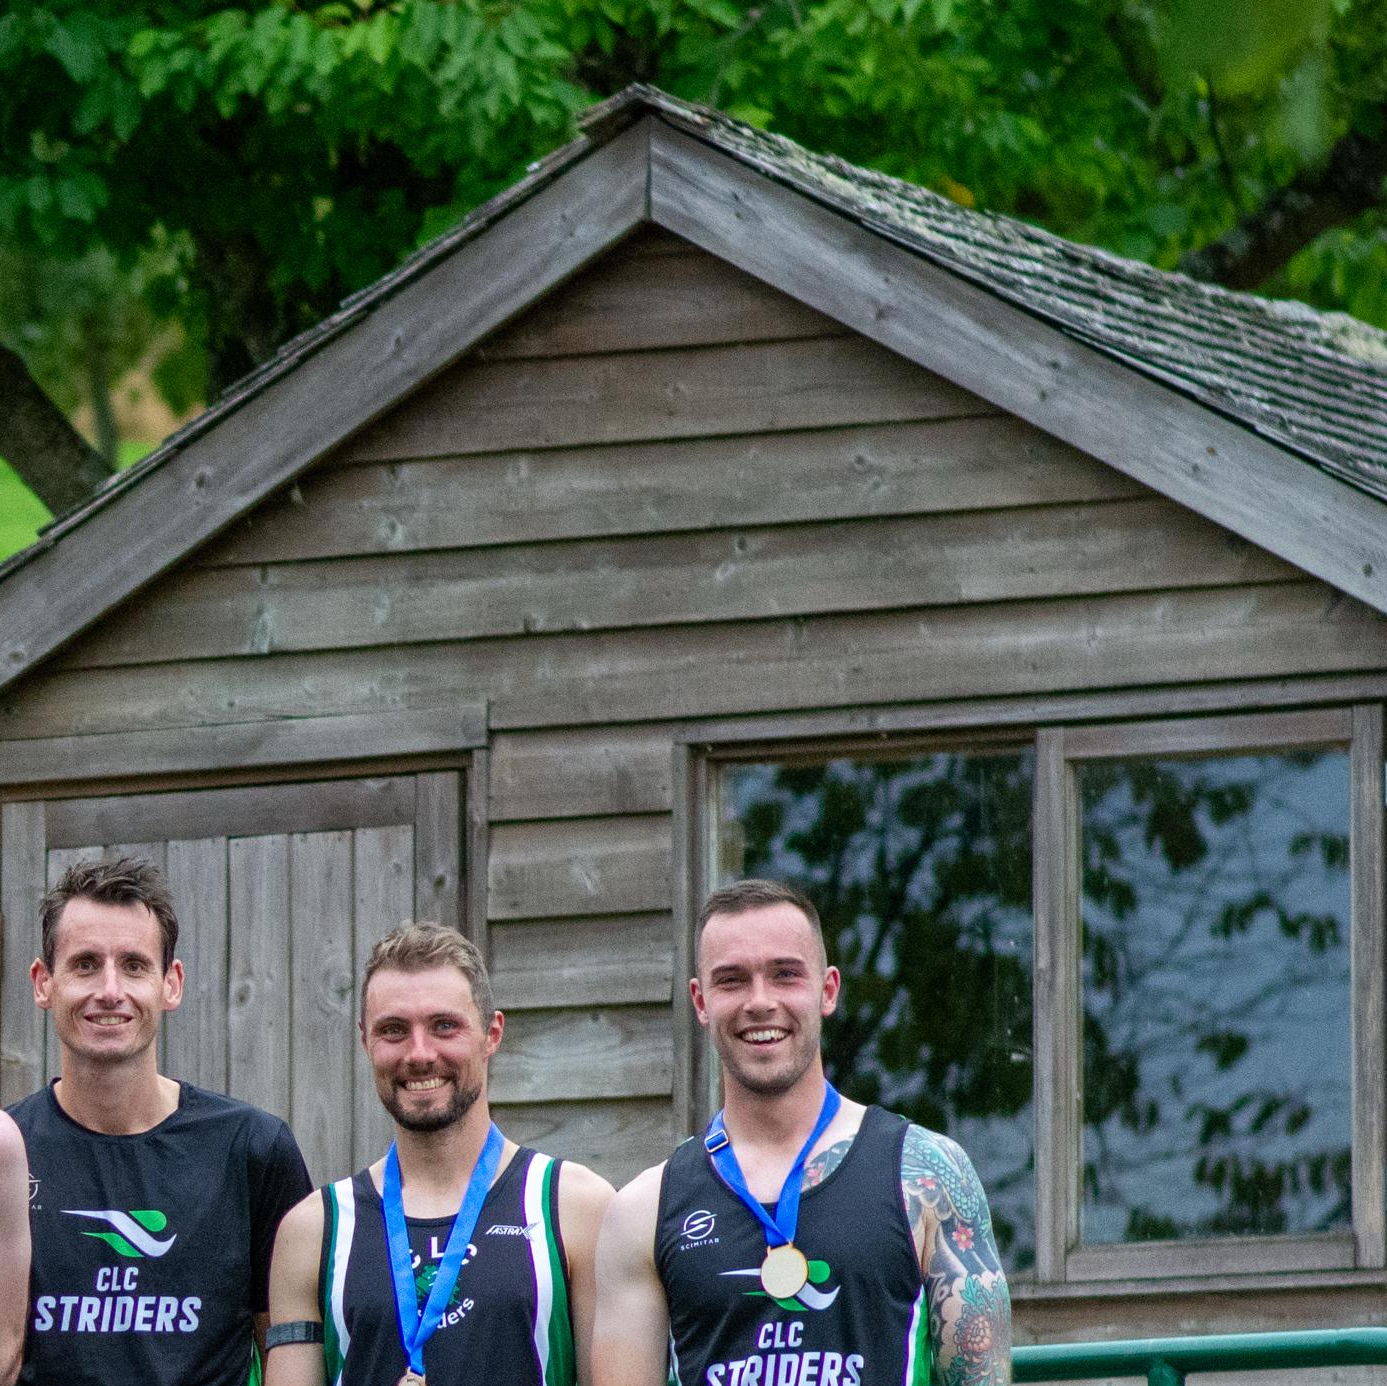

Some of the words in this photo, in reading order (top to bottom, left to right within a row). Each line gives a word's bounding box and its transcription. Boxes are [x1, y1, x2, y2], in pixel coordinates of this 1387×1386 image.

[681, 1238, 719, 1250] SCIMITAR
[96, 1266, 139, 1292] CLC
[35, 1295, 202, 1332] STRIDERS
[758, 1321, 804, 1349] CLC
